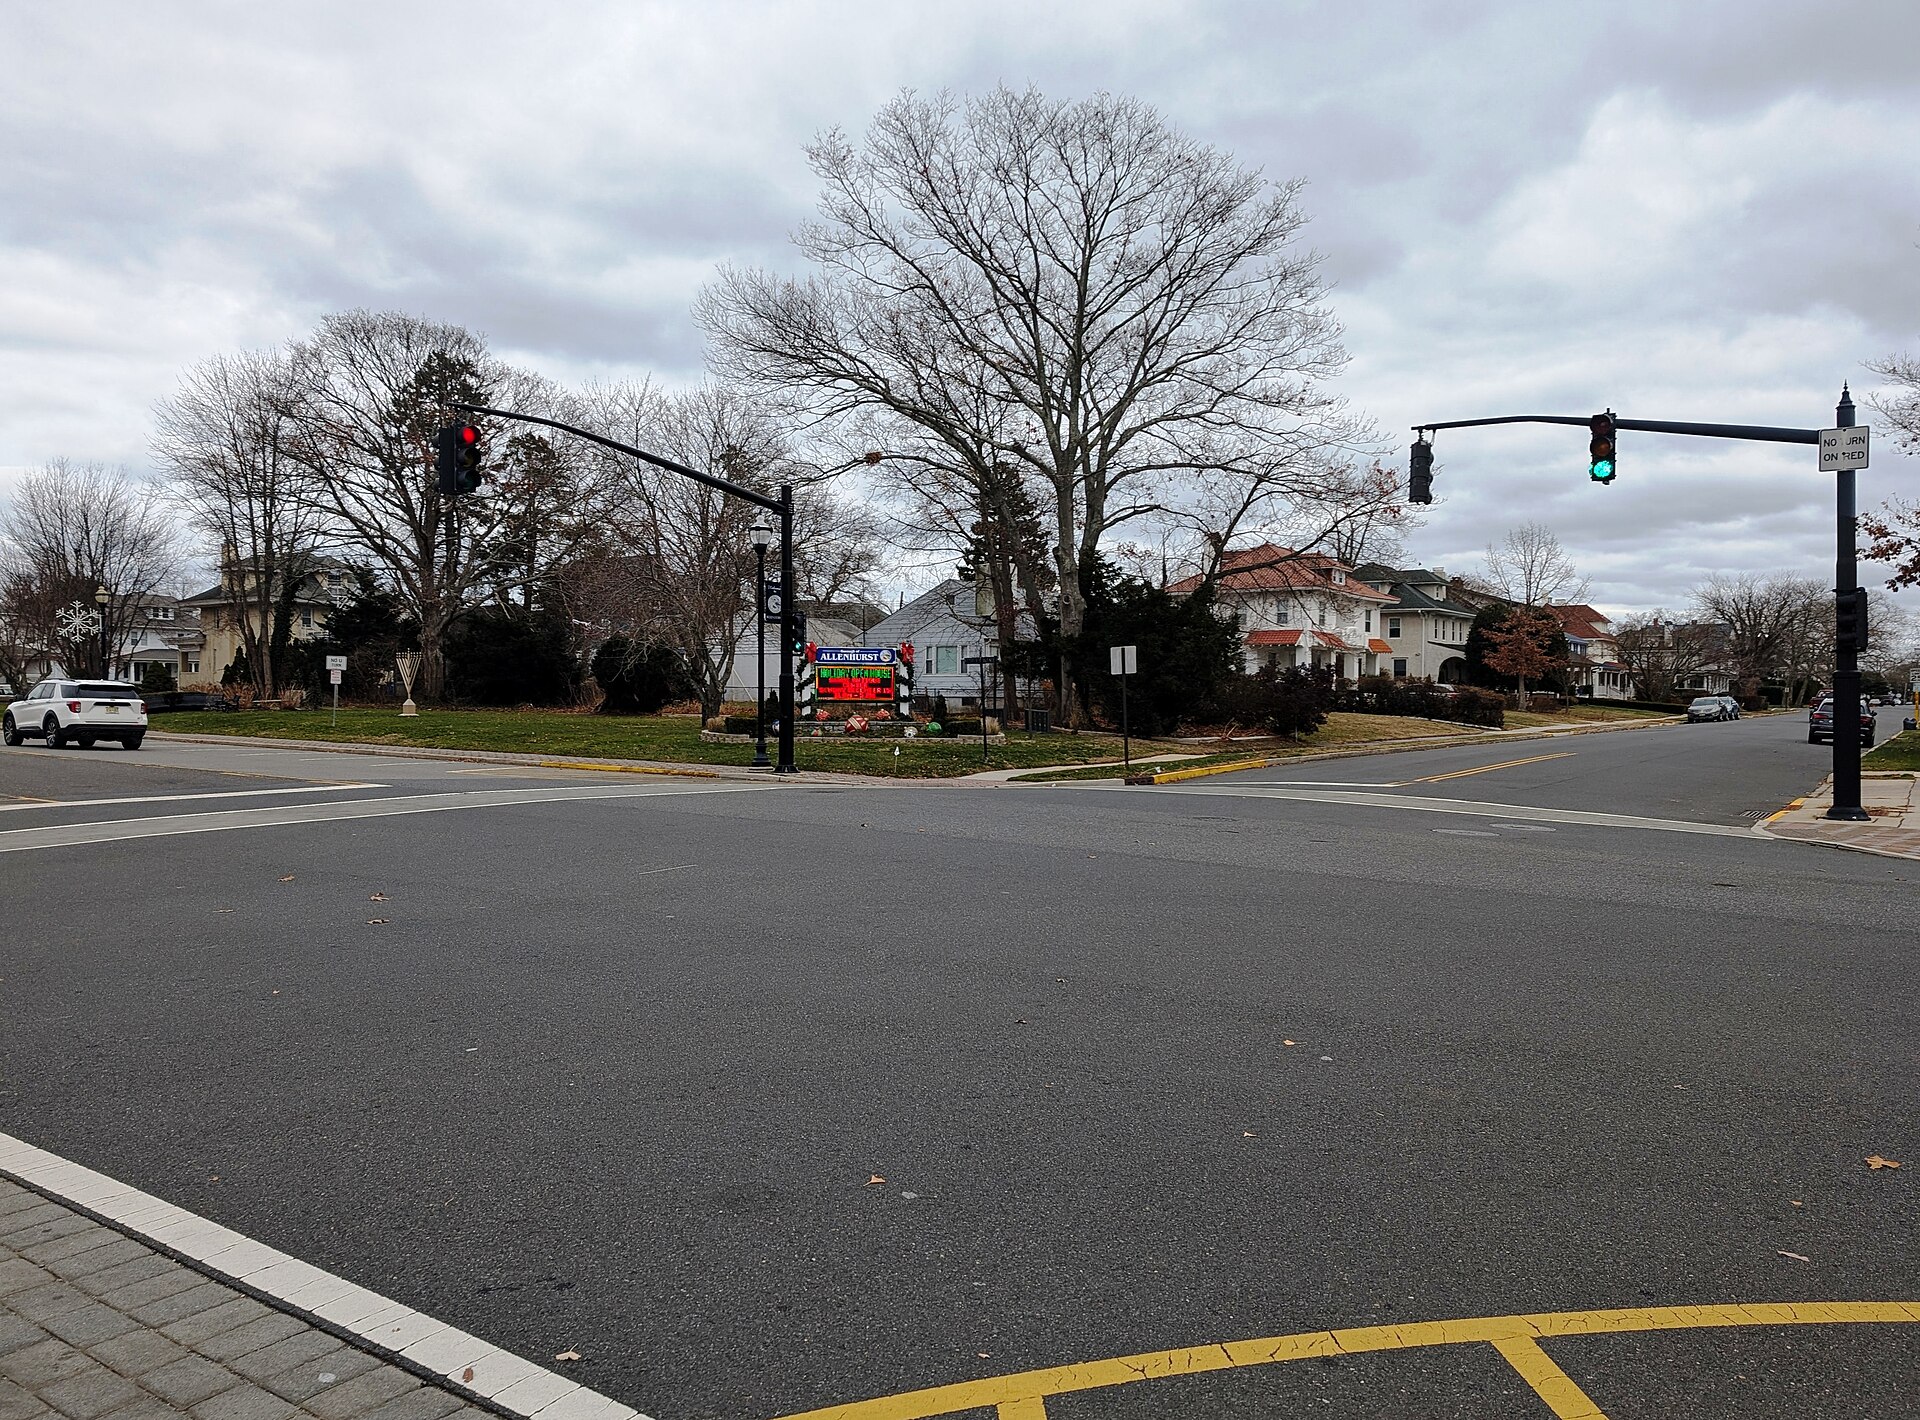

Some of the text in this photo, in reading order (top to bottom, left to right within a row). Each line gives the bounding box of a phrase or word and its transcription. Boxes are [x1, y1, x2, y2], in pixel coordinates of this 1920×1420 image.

[1823, 438, 1837, 447] NO
[1823, 451, 1865, 461] ON RED
[820, 653, 879, 661] ALLENHURST
[820, 668, 891, 678] HOLIDAY OPEN HOUSE
